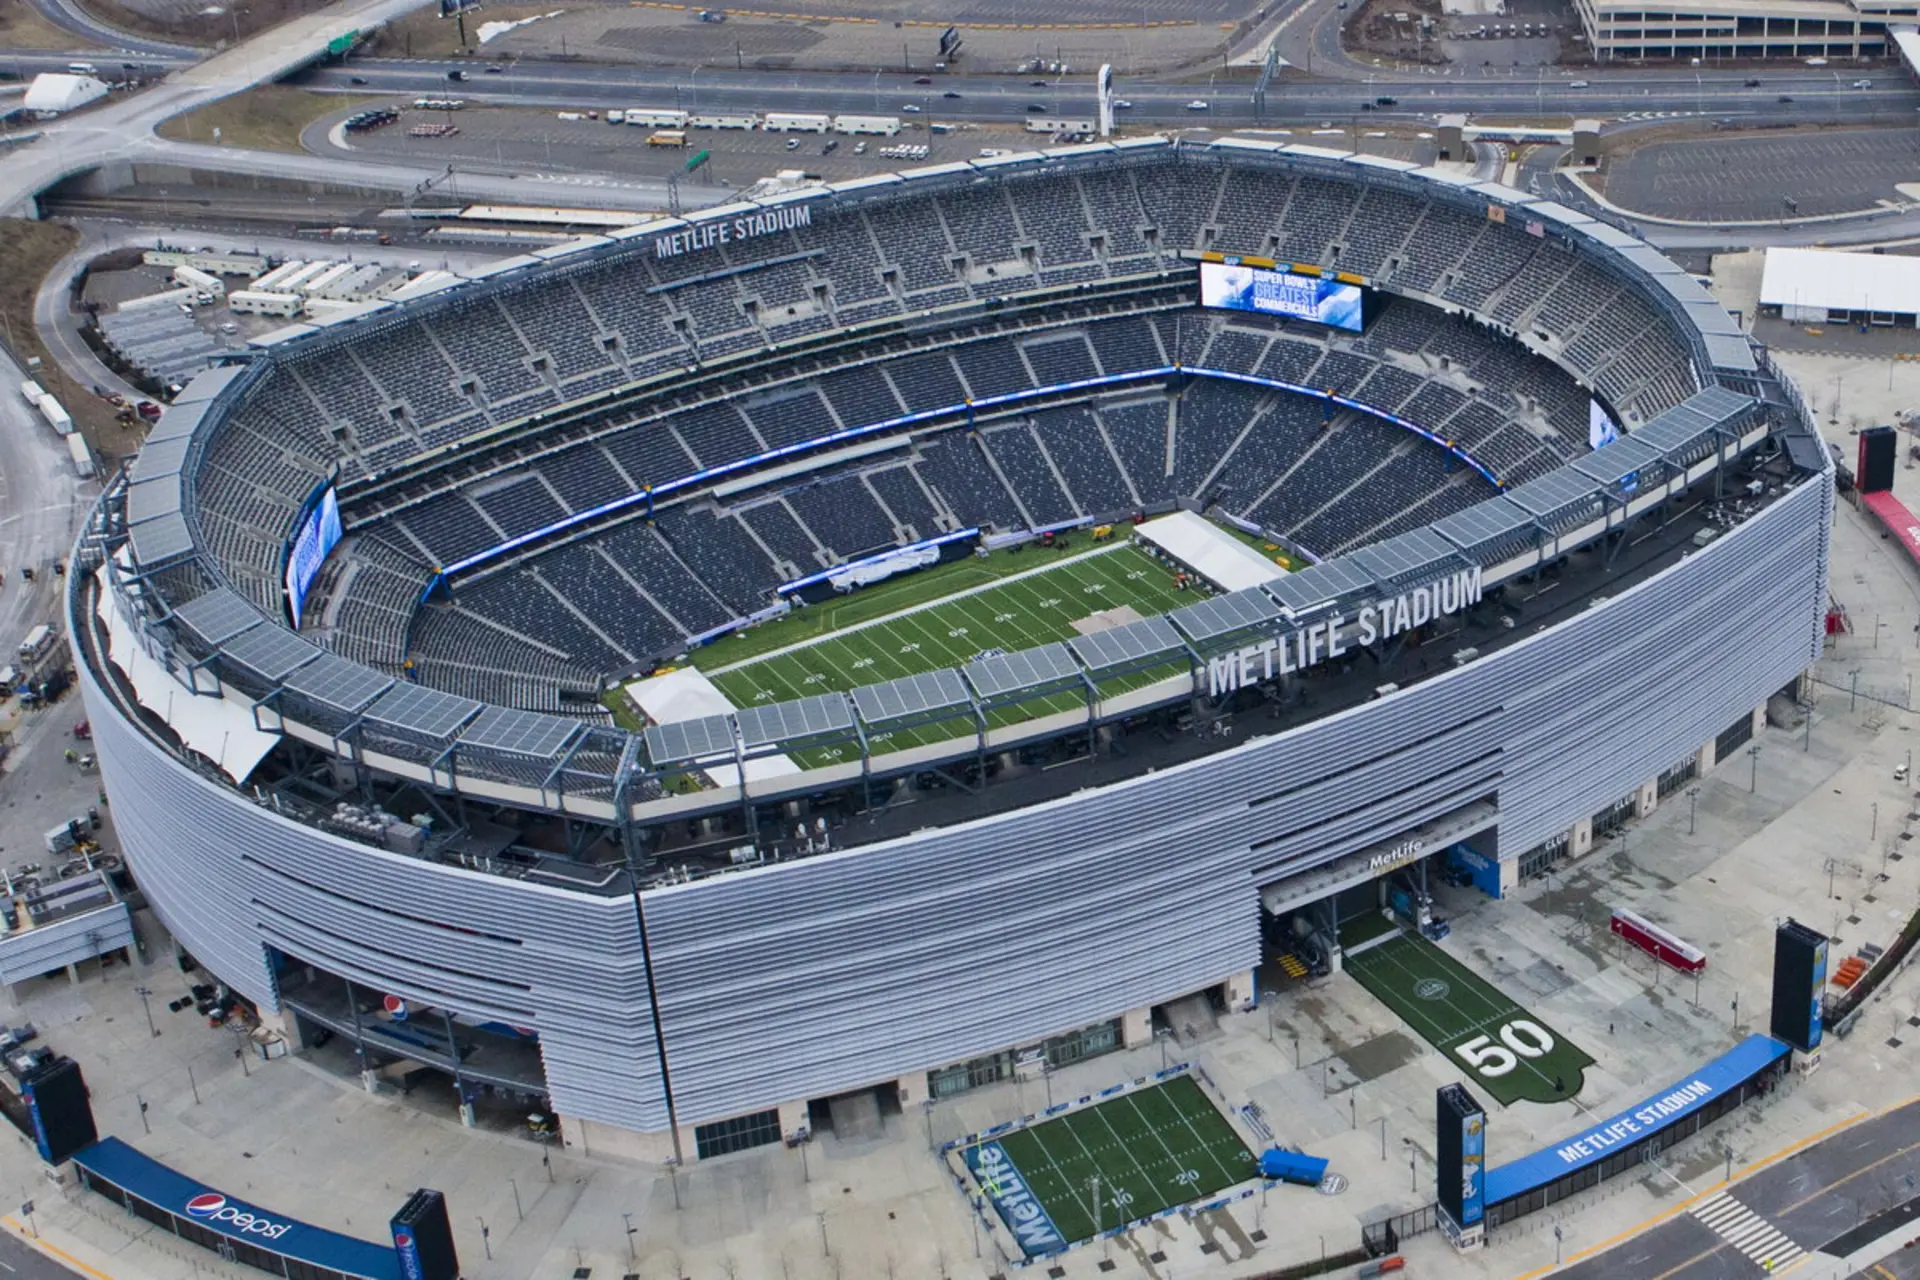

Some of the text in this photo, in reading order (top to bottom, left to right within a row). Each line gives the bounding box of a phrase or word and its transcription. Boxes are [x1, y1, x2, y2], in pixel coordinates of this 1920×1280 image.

[656, 204, 811, 259] METLIFE STADIUM
[1254, 269, 1283, 285] SUPER
[1254, 282, 1318, 306] GREATEST
[1254, 297, 1318, 317] COMMERCIALS
[949, 627, 968, 638] 50
[1208, 565, 1482, 697] METLIFE STADIUM
[1545, 831, 1570, 850] CLUB
[1370, 840, 1422, 869] MetLife
[1454, 1020, 1554, 1077] 50
[1557, 1080, 1712, 1163] METLIFE STADIUM
[1175, 1168, 1200, 1186] 20
[974, 1147, 1059, 1247] MetLife
[1111, 1191, 1134, 1209] 10
[209, 1206, 292, 1239] pepsi
